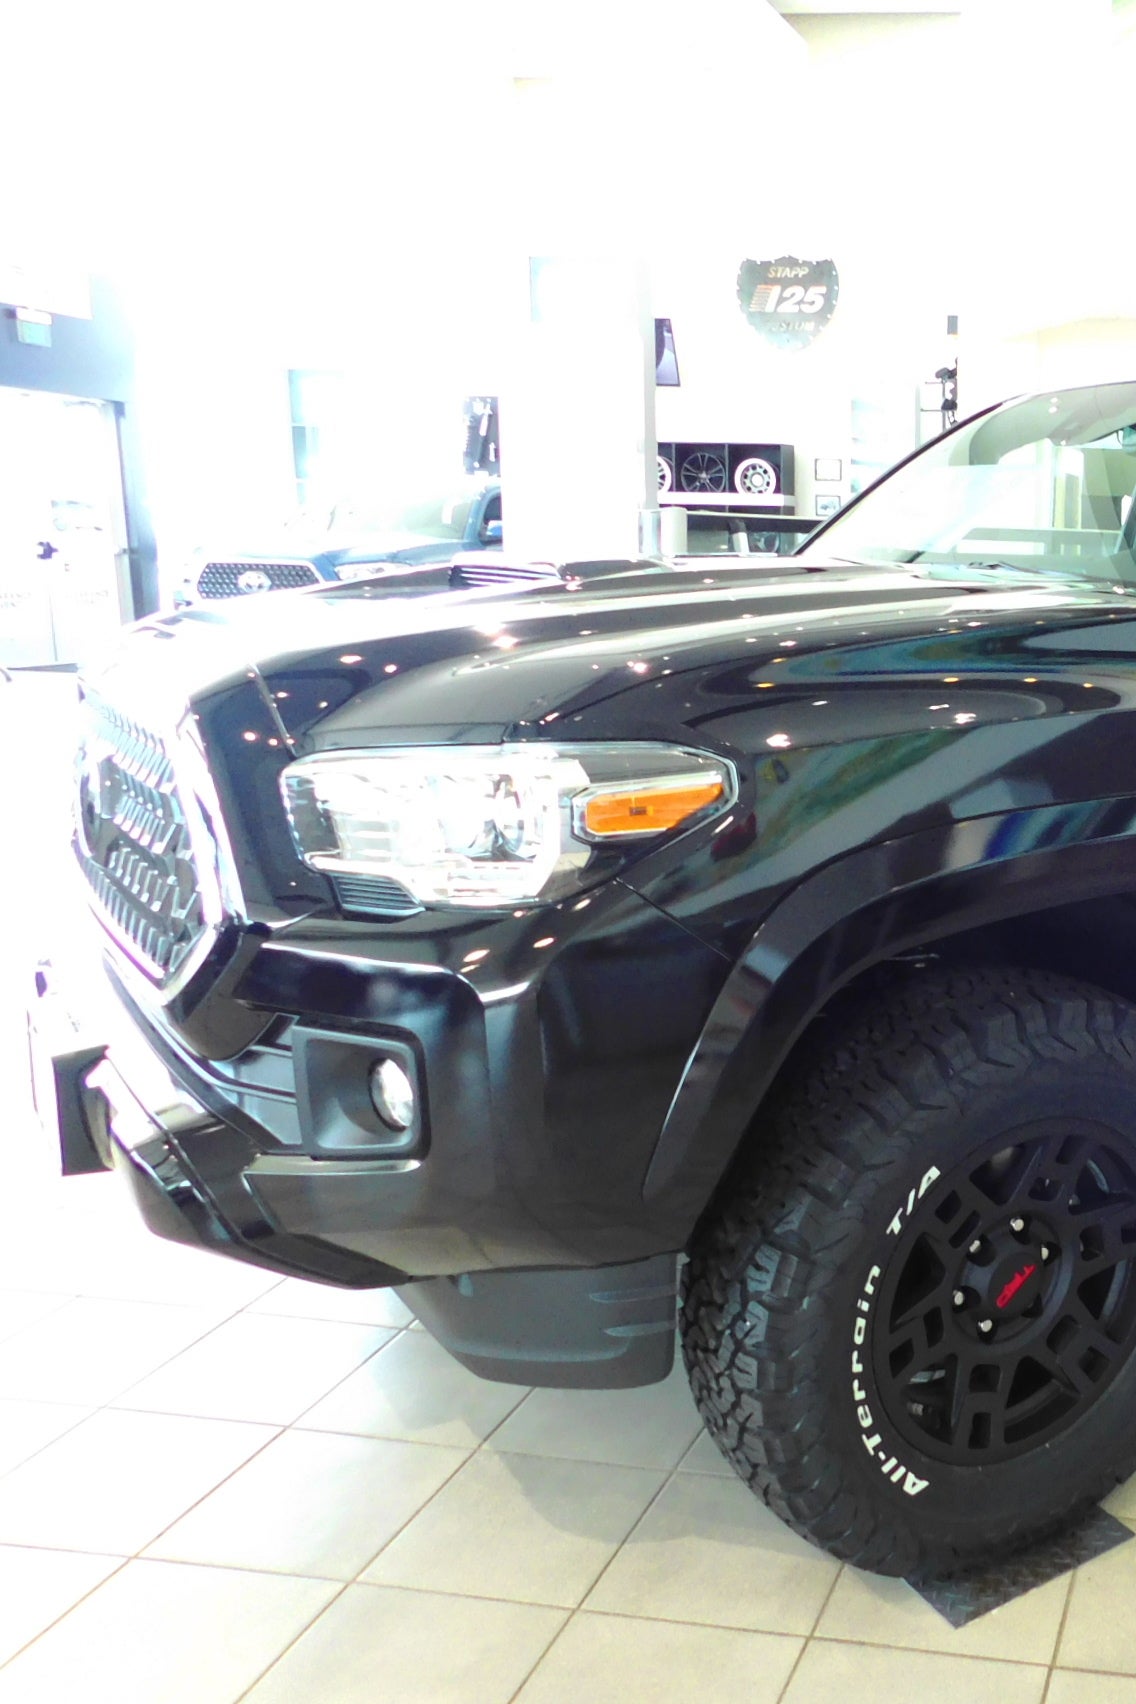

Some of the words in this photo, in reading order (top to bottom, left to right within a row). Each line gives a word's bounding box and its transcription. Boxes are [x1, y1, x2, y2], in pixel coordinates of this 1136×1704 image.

[767, 266, 809, 278] STAPP
[885, 1165, 942, 1236] T/A
[851, 1263, 930, 1496] All-Terrain
